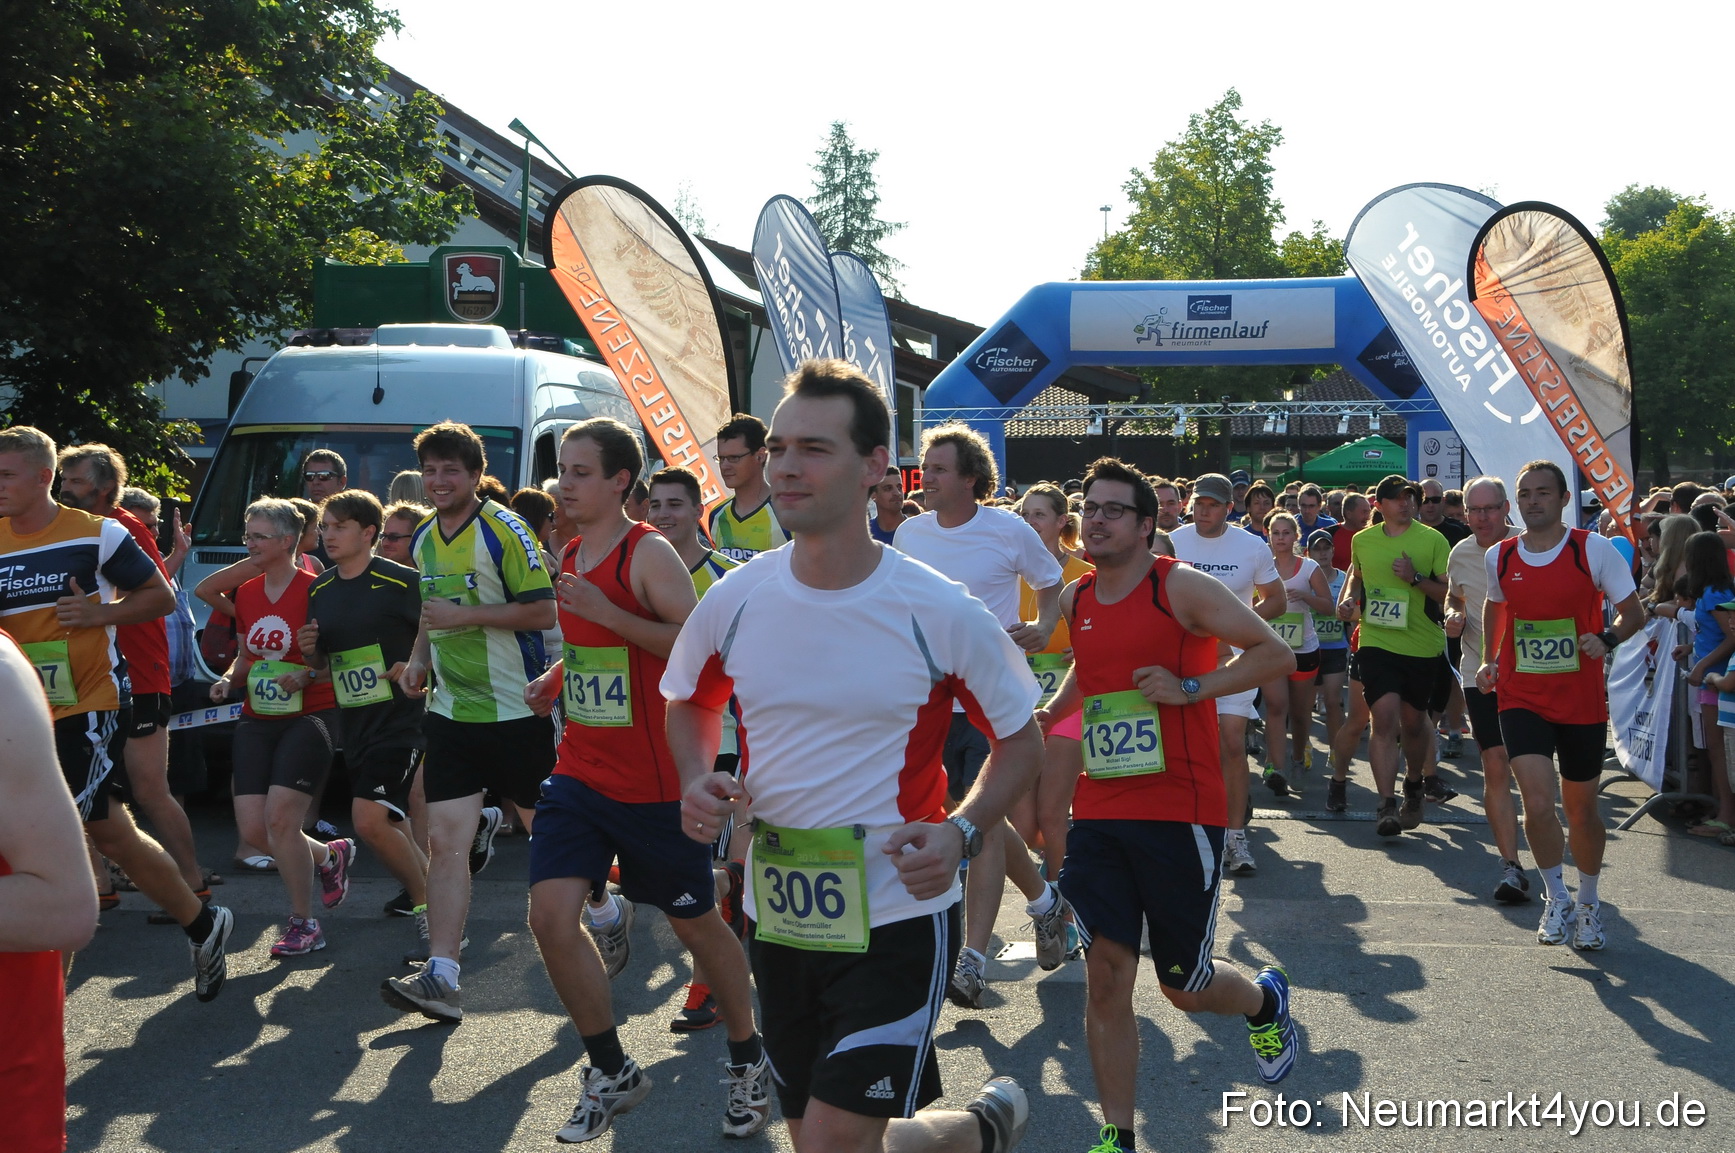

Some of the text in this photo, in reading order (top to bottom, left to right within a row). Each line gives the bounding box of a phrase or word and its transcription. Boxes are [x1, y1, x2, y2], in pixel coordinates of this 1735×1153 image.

[462, 307, 486, 316] 1628
[1197, 303, 1229, 312] Fischer
[1172, 320, 1269, 339] firmenlauf
[986, 356, 1037, 367] Fischer
[494, 510, 542, 572] BOCK
[719, 547, 761, 560] BOC
[1194, 562, 1239, 572] Egner
[0, 572, 68, 592] Fischer
[6, 584, 64, 599] AUTOMOBILE
[1370, 600, 1401, 619] 274
[250, 627, 285, 651] 48
[1516, 637, 1575, 660] 1320
[35, 665, 59, 690] 7
[338, 667, 378, 693] 109
[565, 671, 627, 707] 1314
[1083, 719, 1158, 758] 1325
[672, 898, 697, 907] adidas
[764, 867, 846, 919] 306
[865, 1088, 895, 1099] adidas
